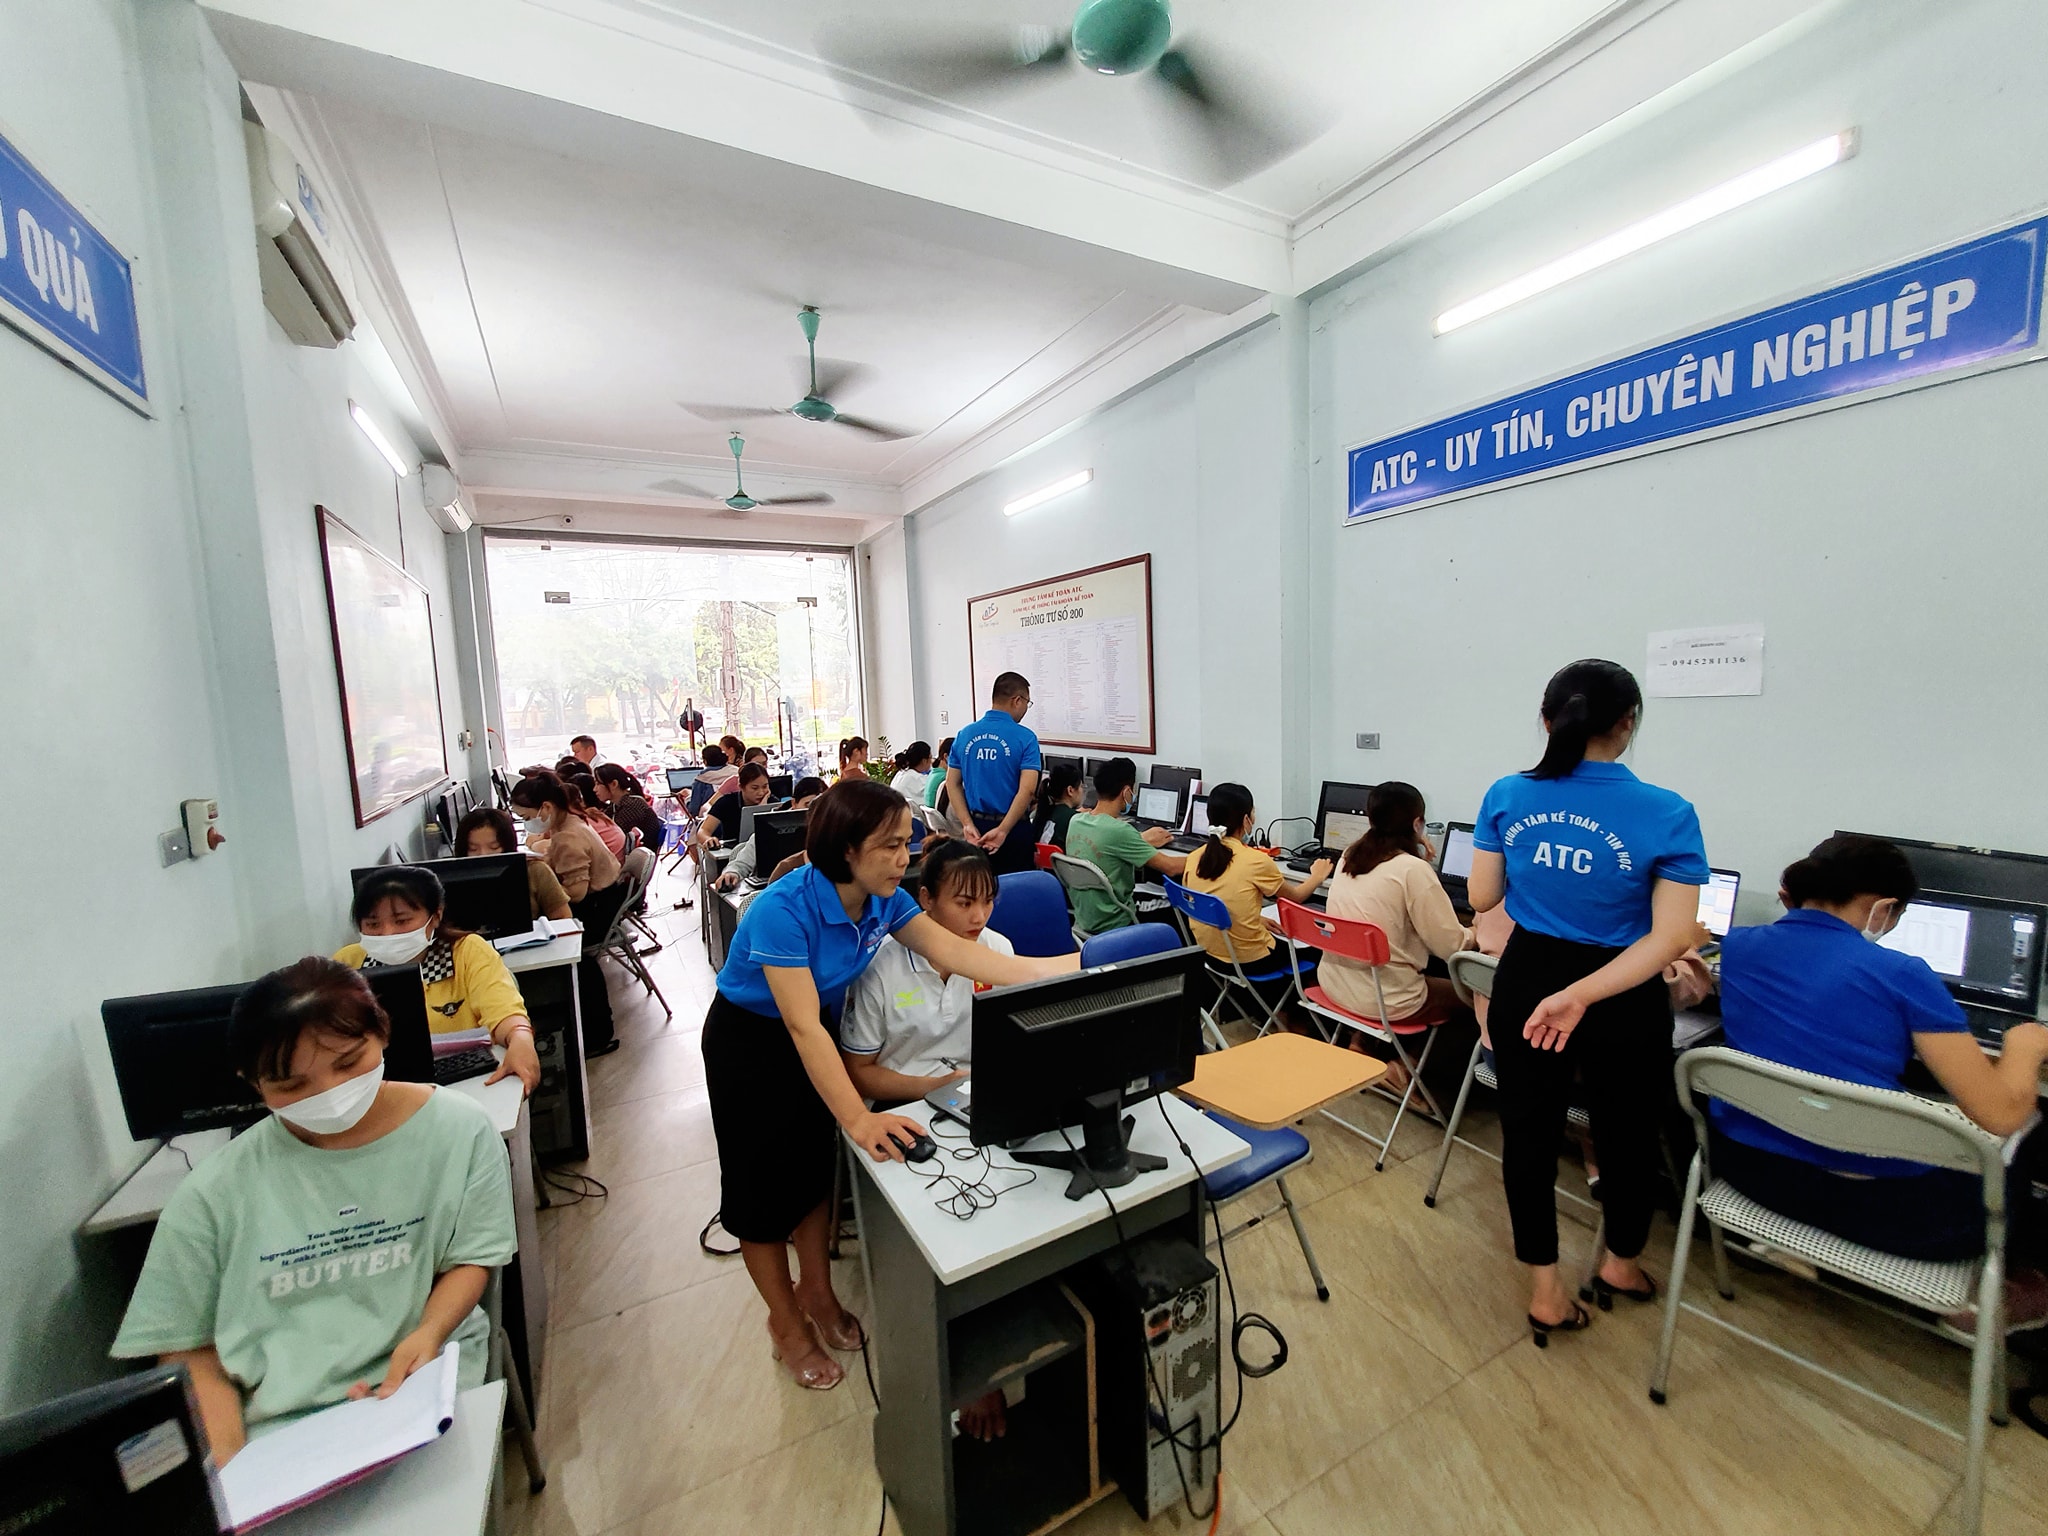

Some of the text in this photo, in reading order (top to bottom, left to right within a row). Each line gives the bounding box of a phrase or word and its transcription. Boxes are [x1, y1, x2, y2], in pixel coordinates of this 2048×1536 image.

[17, 208, 100, 335] QUẢ
[1371, 450, 1417, 494] ATC
[1446, 429, 1483, 472] UY
[1491, 408, 1554, 459] TÍN,
[1566, 353, 1735, 439] CHUYÊN
[1751, 278, 1977, 388] NGHIỆP
[1046, 610, 1057, 623] TƯ
[1057, 604, 1069, 621] SỐ
[1069, 607, 1084, 619] 200
[976, 748, 997, 760] ATC
[1504, 822, 1525, 846] TRUNG
[1522, 813, 1549, 828] TÂM
[1550, 810, 1567, 823] KẾ
[1568, 813, 1600, 833] TOÁN
[1604, 832, 1625, 850] TIN
[1616, 851, 1632, 871] HỌC
[1533, 841, 1593, 874] ATC
[269, 1241, 413, 1299] BUTTER
